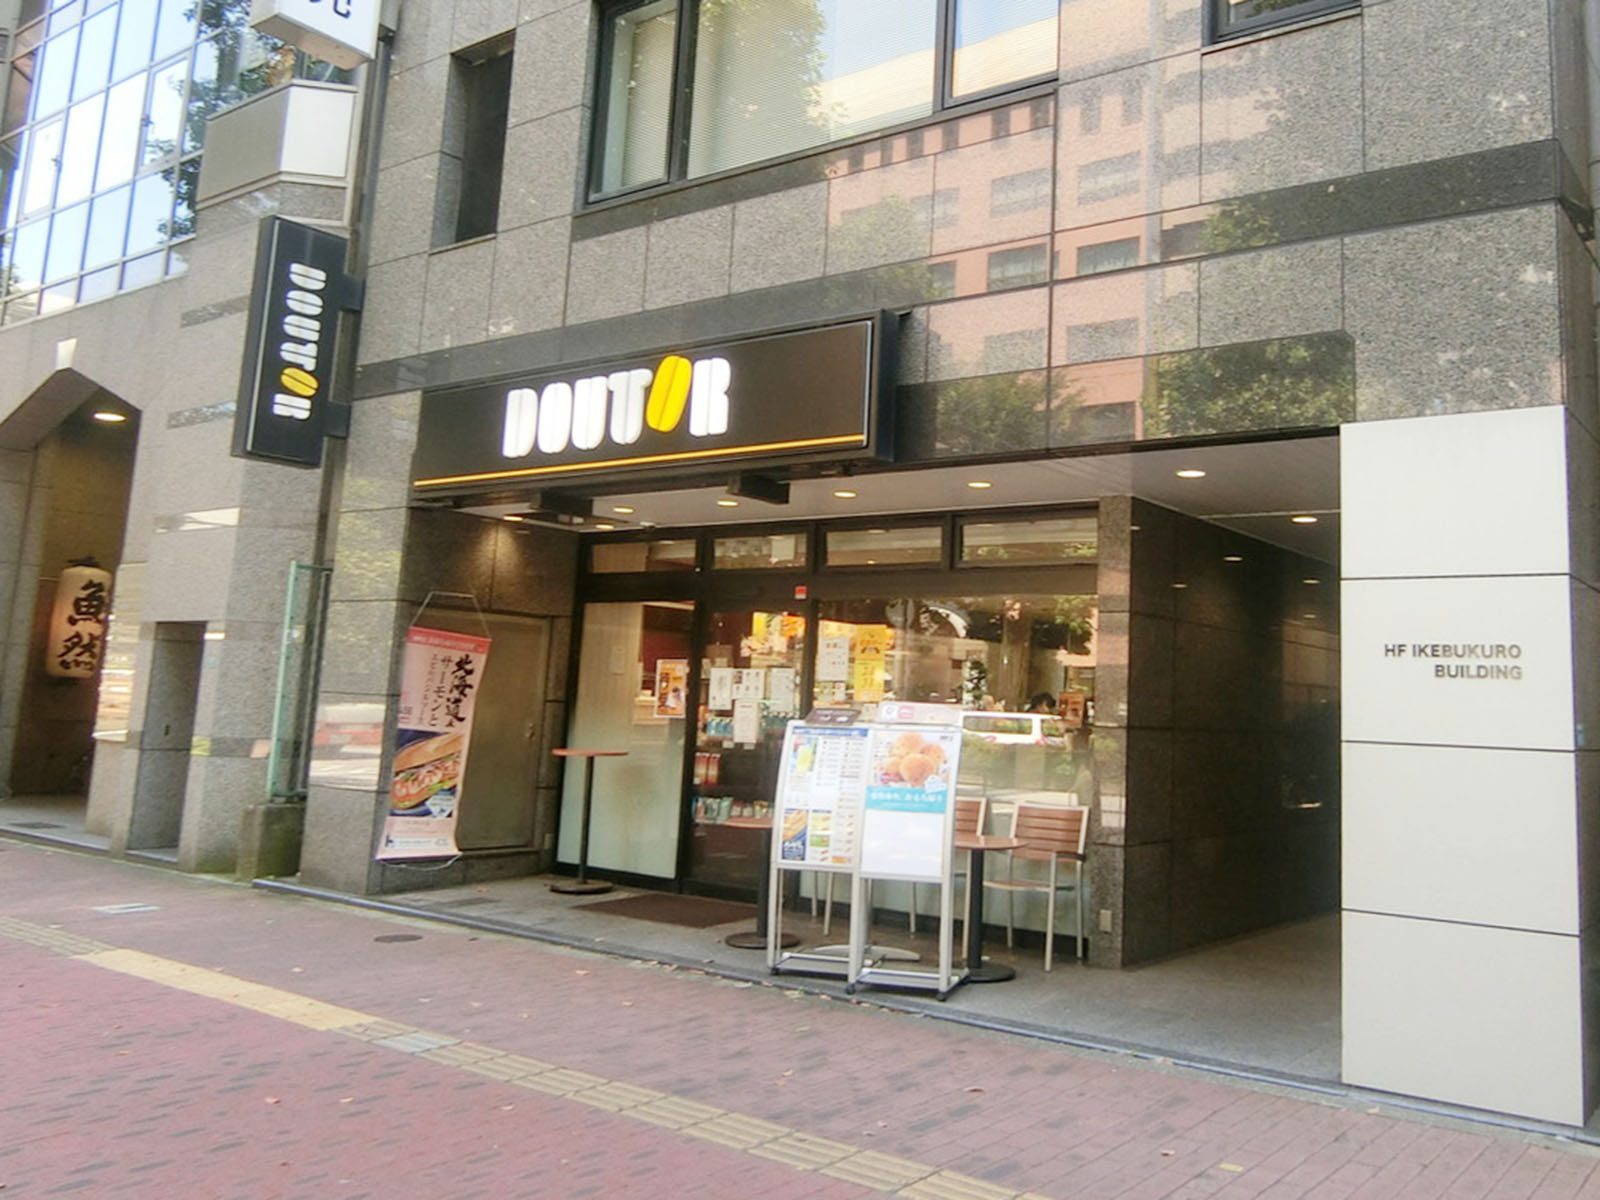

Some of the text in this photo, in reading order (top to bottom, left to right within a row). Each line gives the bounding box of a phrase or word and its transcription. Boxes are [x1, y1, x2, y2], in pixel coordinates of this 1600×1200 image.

[272, 262, 327, 420] DOUTOR
[502, 354, 732, 459] DOUTOR
[57, 579, 104, 671] 魚然
[1384, 643, 1522, 660] HF IKEBUKURO
[1434, 663, 1522, 681] BUILDING
